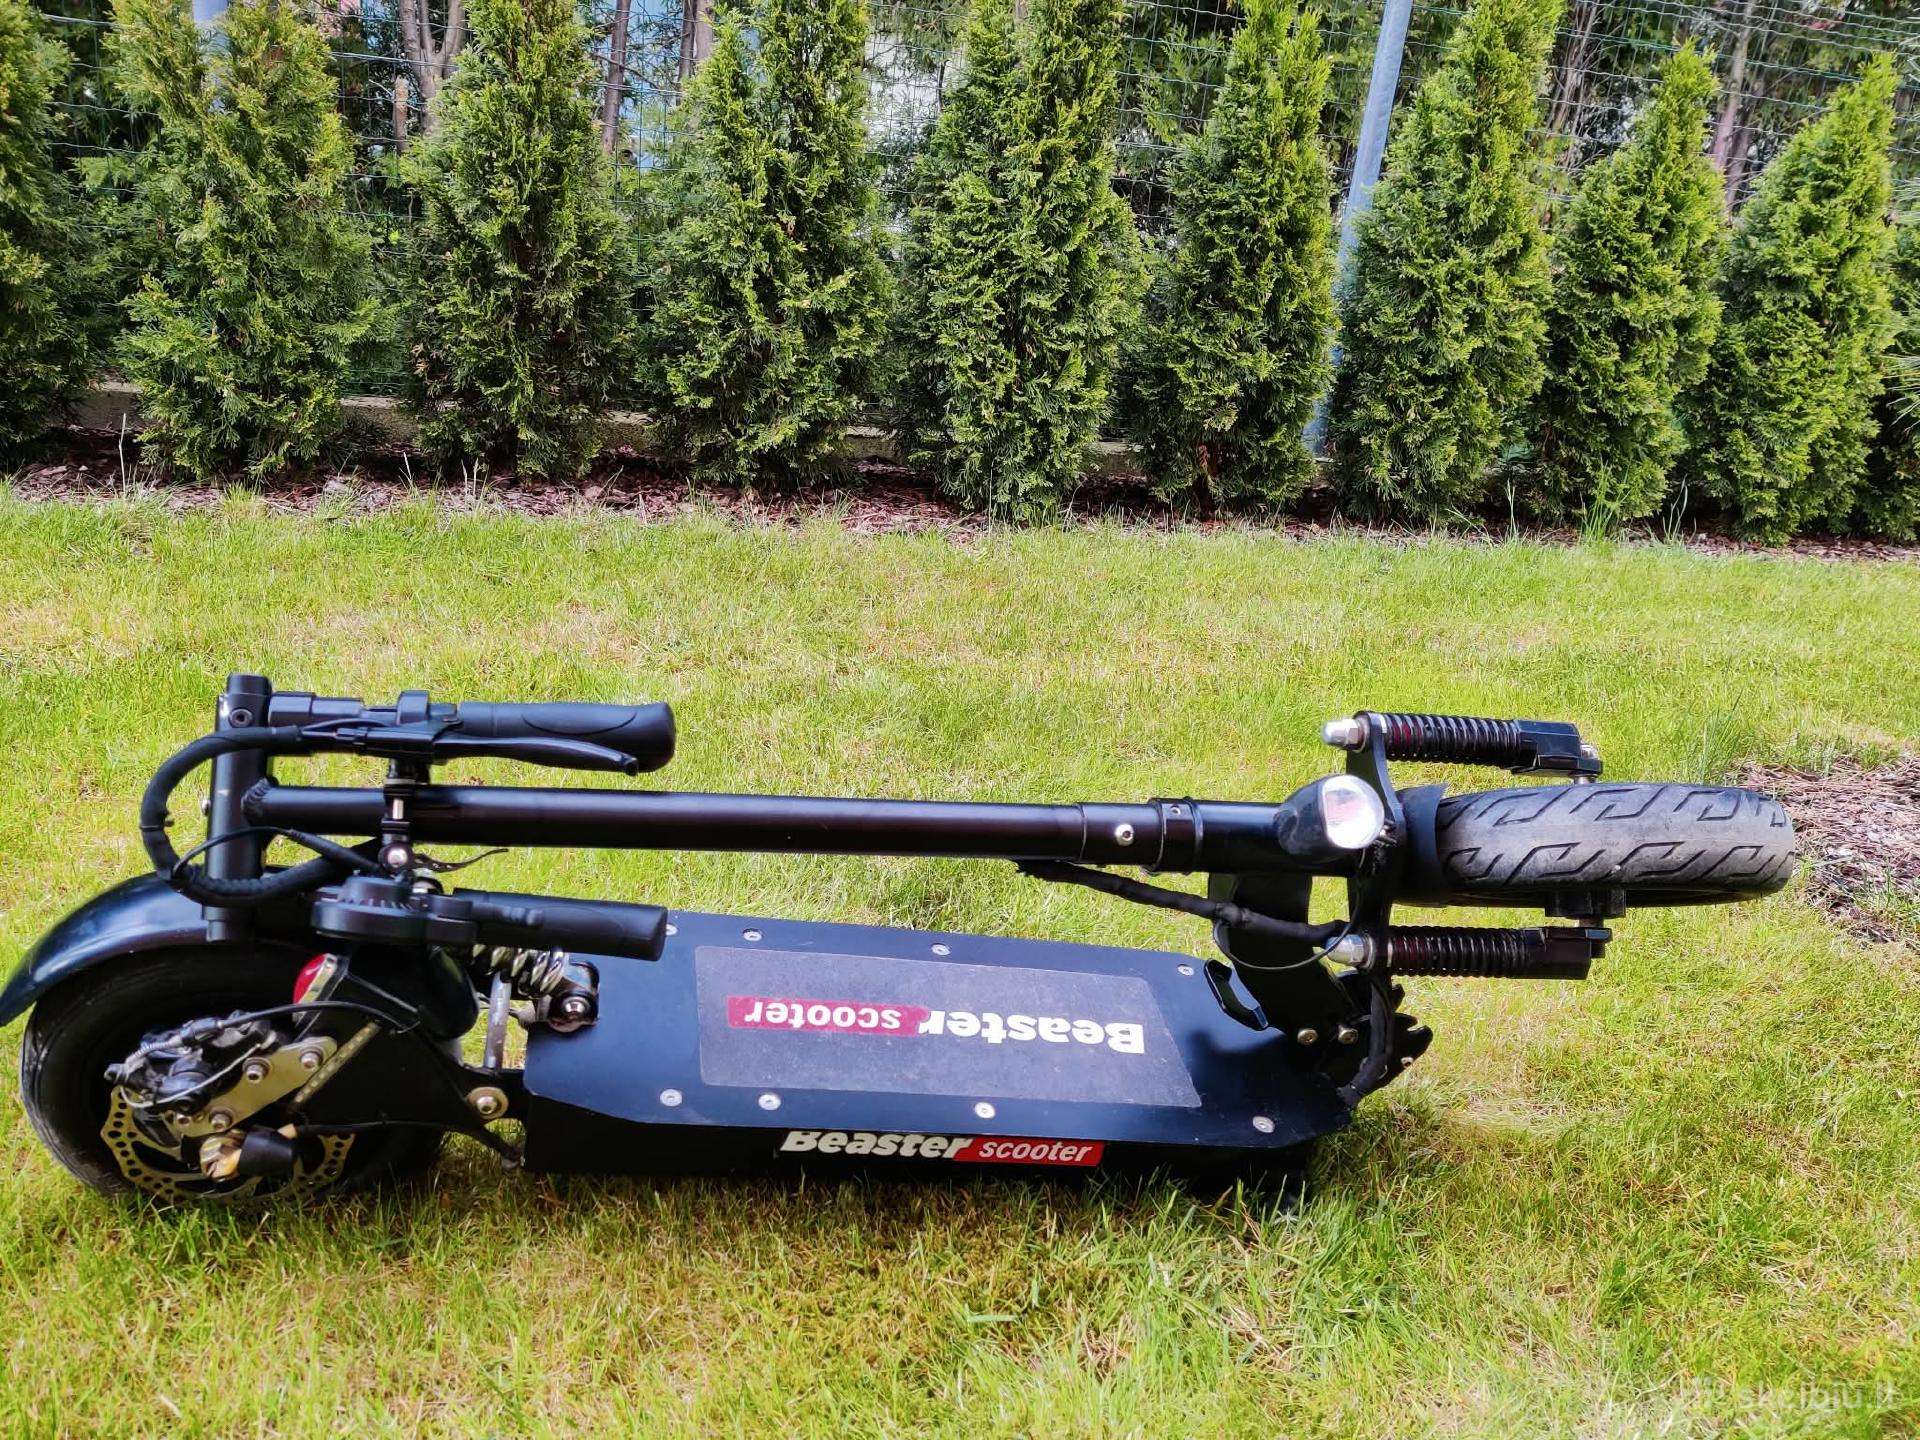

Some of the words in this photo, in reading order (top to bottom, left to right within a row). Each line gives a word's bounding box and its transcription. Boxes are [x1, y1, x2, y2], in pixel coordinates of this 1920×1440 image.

[744, 1001, 901, 1029] scooter
[918, 1010, 1145, 1054] Beaster
[780, 1131, 974, 1159] Beaster
[978, 1139, 1093, 1162] scooter
